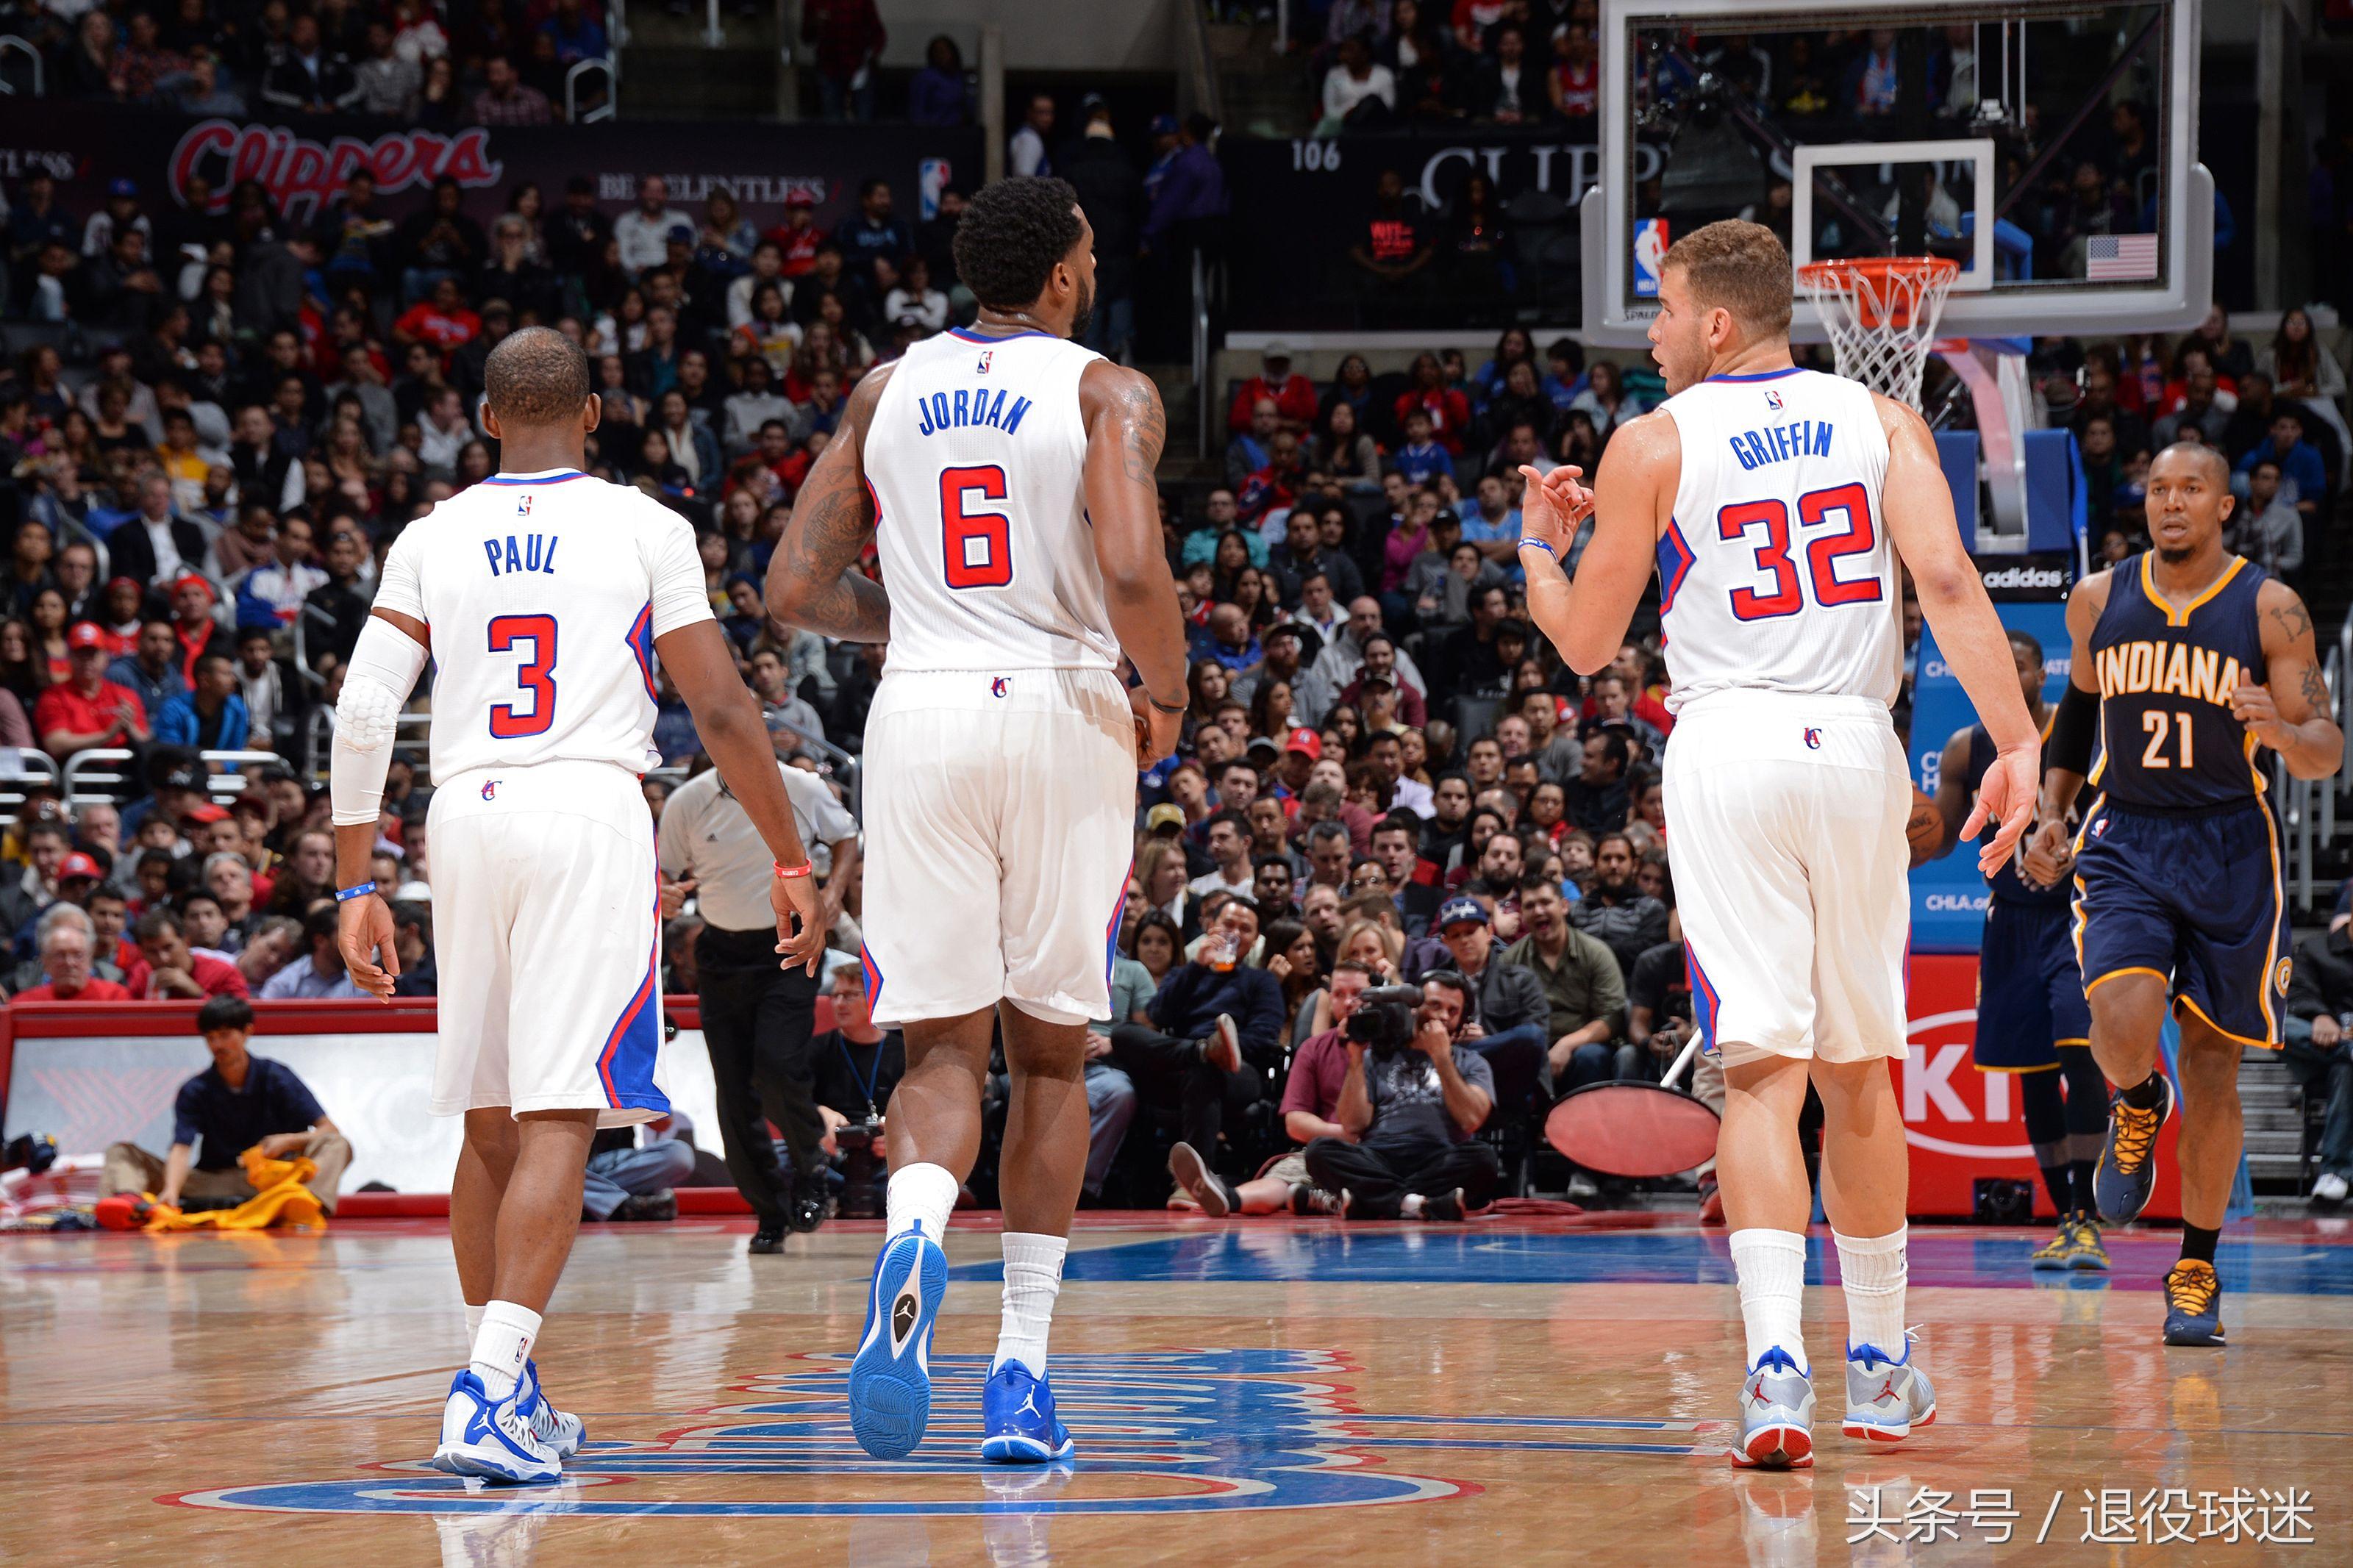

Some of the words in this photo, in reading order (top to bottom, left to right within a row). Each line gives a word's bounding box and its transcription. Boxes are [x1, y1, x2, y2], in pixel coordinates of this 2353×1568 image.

[168, 118, 504, 228] Clippers
[1291, 140, 1341, 171] 106
[599, 173, 635, 200] BE
[918, 388, 1033, 437] JORDAN
[1729, 420, 1834, 470] GRIFFIN
[484, 534, 559, 577] PAUL
[938, 465, 1013, 590] 6
[1717, 481, 1883, 622] 32
[1982, 567, 2063, 588] adidas
[487, 613, 559, 740] 3
[2096, 640, 2240, 711] INDIANA
[2142, 709, 2193, 768] 21
[1902, 1043, 2027, 1123] KI
